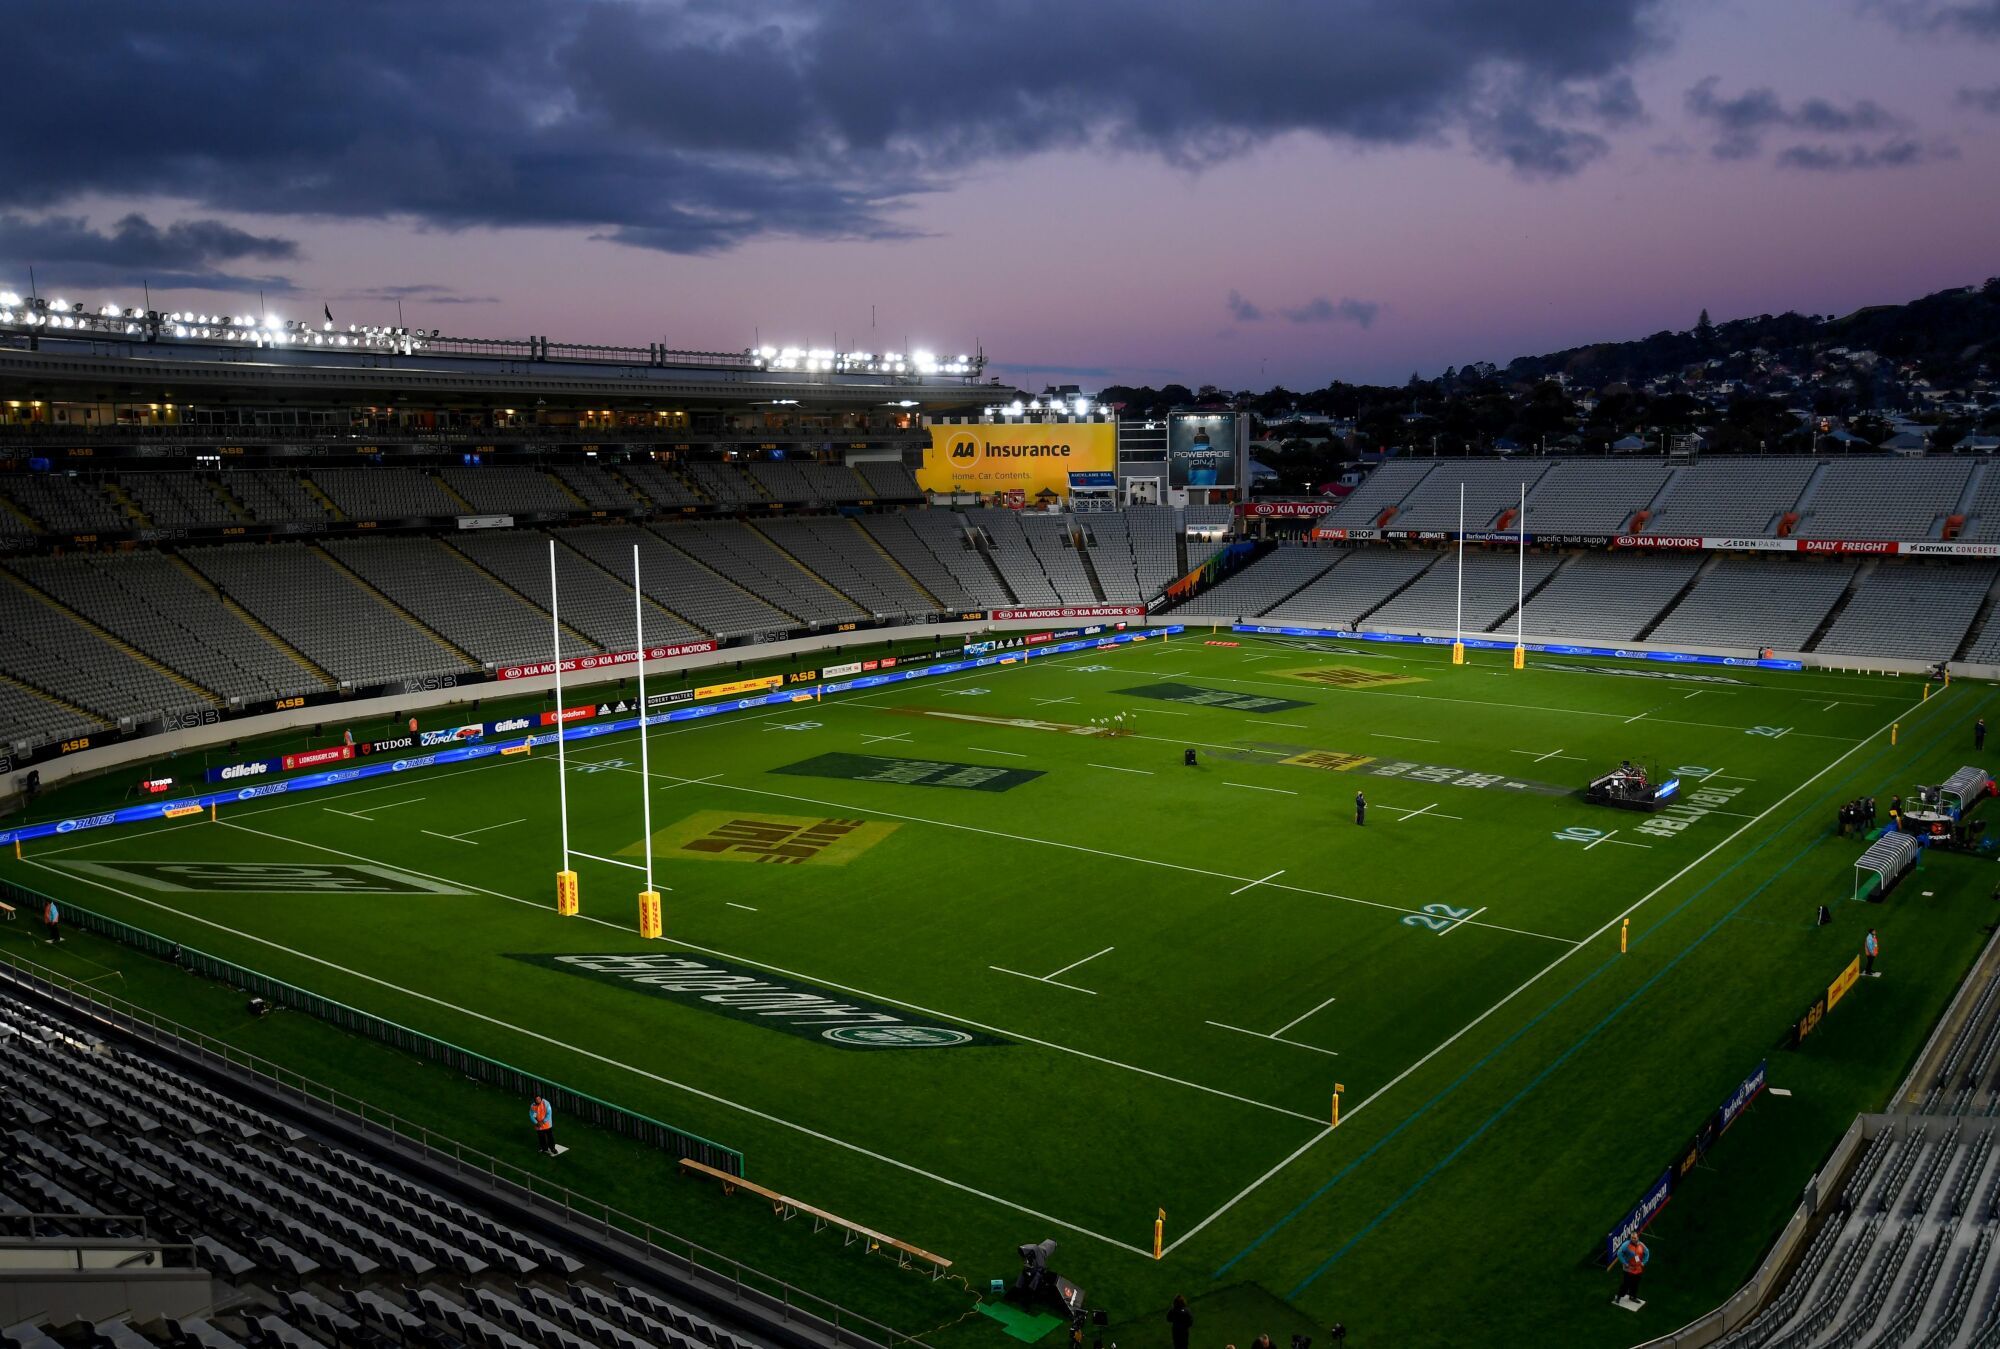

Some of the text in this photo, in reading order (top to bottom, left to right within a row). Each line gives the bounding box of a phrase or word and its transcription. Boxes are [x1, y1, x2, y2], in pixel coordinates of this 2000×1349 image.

[952, 442, 975, 458] AA
[986, 442, 1071, 457] Insurance
[1173, 450, 1231, 458] POWERADE
[995, 472, 1032, 480] Contents.
[1277, 504, 1294, 514] KIA
[1318, 529, 1374, 539] STIHL SHOP
[1387, 531, 1408, 539] MITRE
[1537, 535, 1561, 543] pacific
[1583, 537, 1608, 545] supply
[1637, 537, 1699, 547] KIA MOTORS
[1806, 540, 1889, 552] DAILY FREIGHT
[1956, 546, 1997, 554] CONCRETE
[962, 613, 982, 621] ASB
[1029, 610, 1060, 618] MOTORS
[1077, 607, 1123, 616] KIA MOTORS
[838, 623, 856, 632] ASB
[667, 643, 711, 656] KIA MOTORS
[599, 656, 613, 666] KIA
[524, 661, 576, 676] KIA MOORS
[789, 670, 817, 683] ASB
[275, 696, 304, 711] ASB
[163, 708, 220, 734] ASB
[561, 710, 586, 719] odafone
[495, 718, 530, 733] Gillette
[374, 737, 412, 751] TUDOR
[421, 730, 453, 747] Ford
[61, 738, 90, 753] ASB
[221, 763, 268, 780] Gillette
[150, 777, 173, 786] TUDOR
[253, 782, 288, 796] BLUES
[75, 813, 115, 829] BLUES
[1553, 827, 1602, 842] 10
[1401, 903, 1470, 930] 22
[1799, 1000, 1824, 1042] ASB
